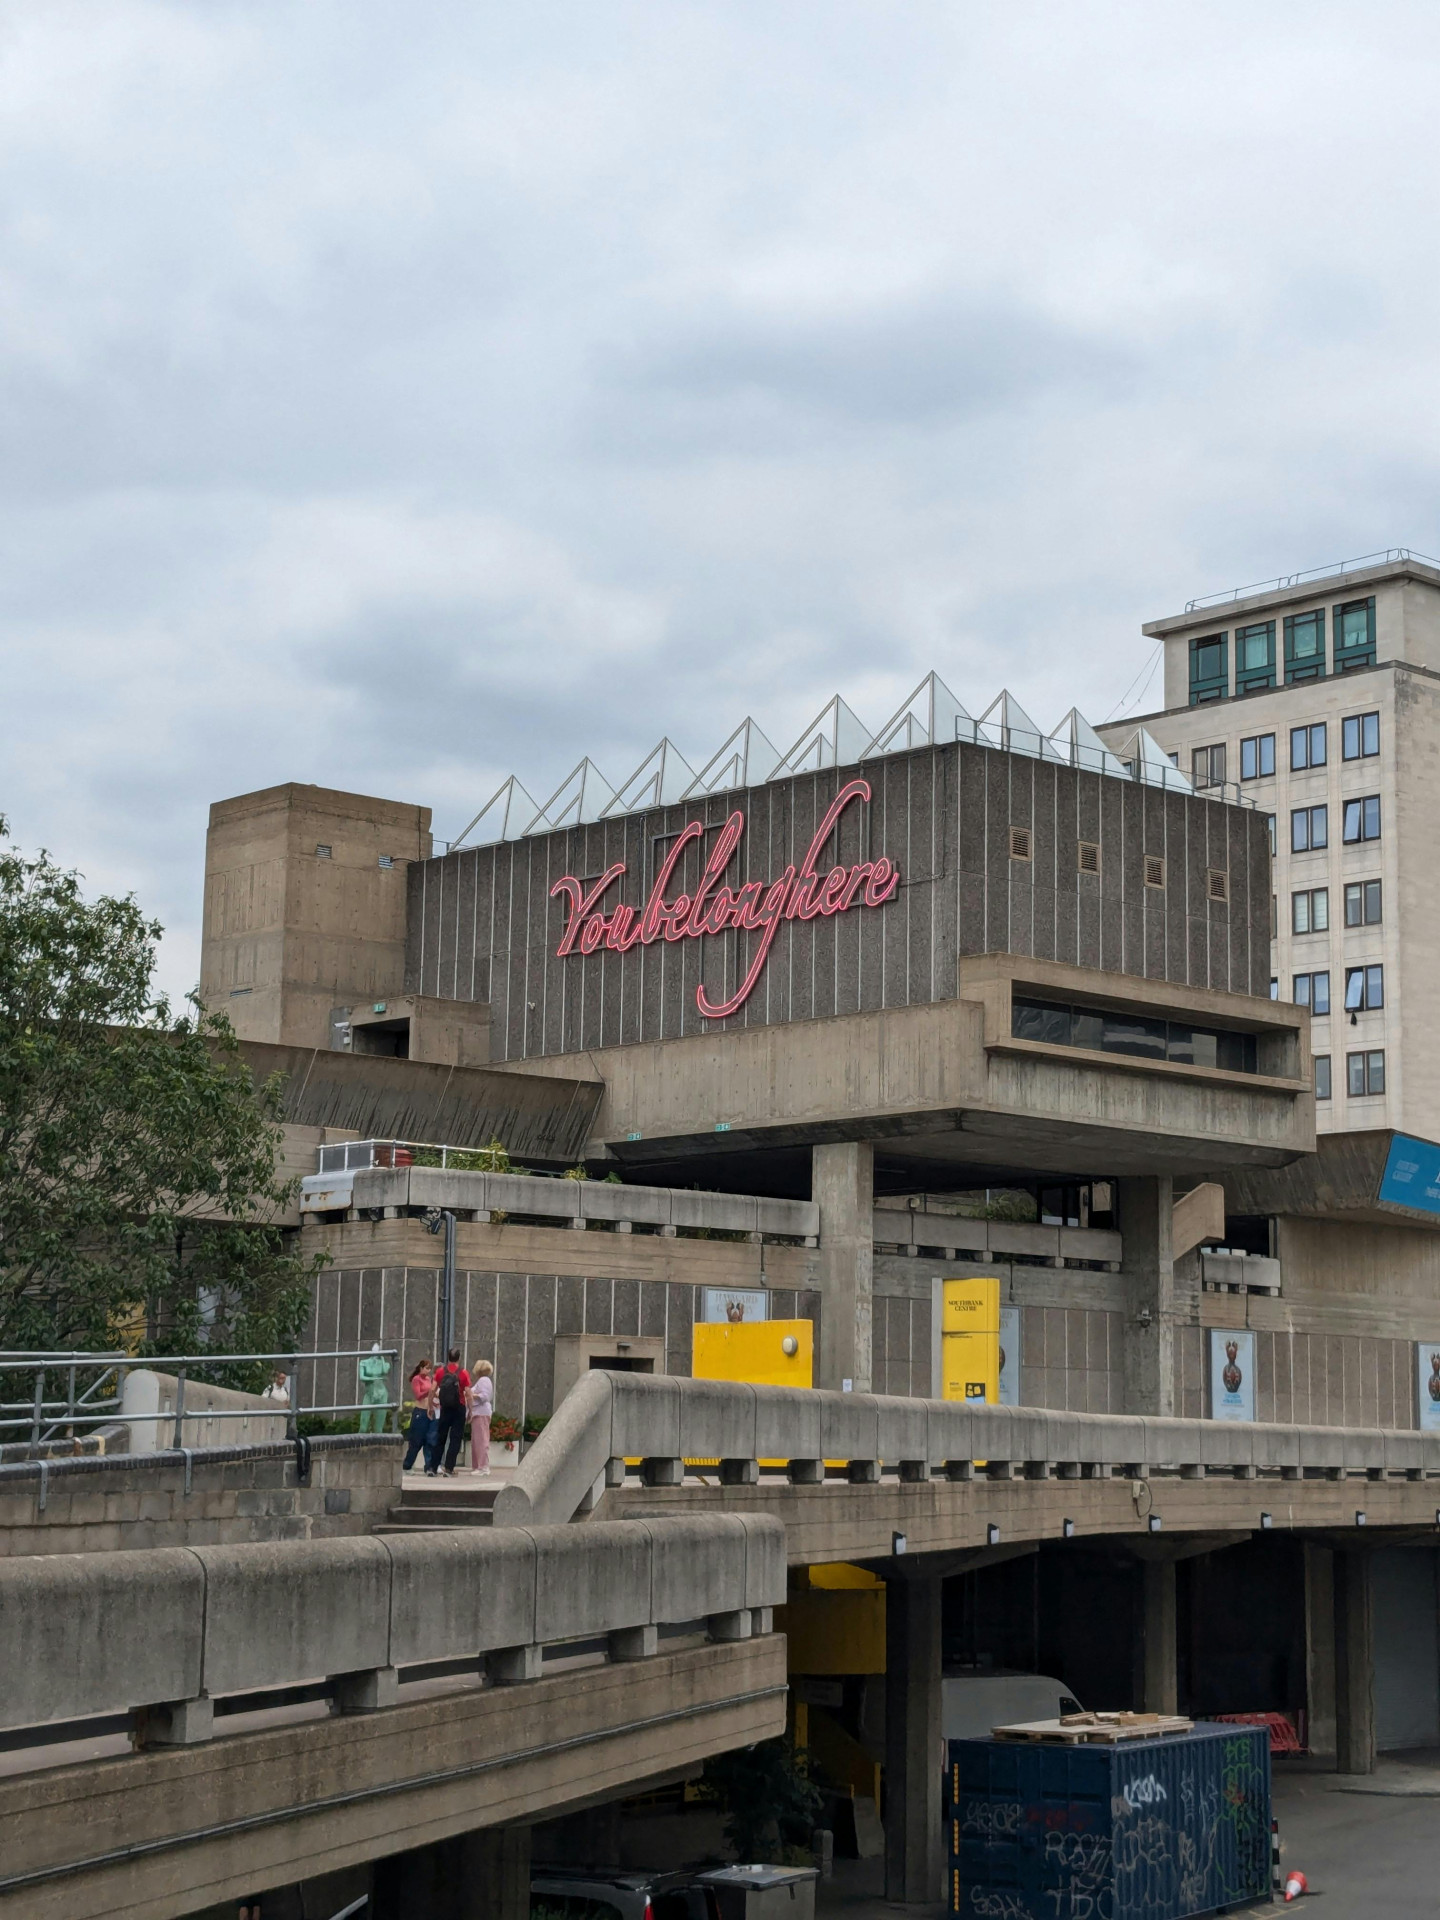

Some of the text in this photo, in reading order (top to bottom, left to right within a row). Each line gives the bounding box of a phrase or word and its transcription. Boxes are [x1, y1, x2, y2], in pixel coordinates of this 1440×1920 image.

[550, 779, 901, 1018] You belong here
